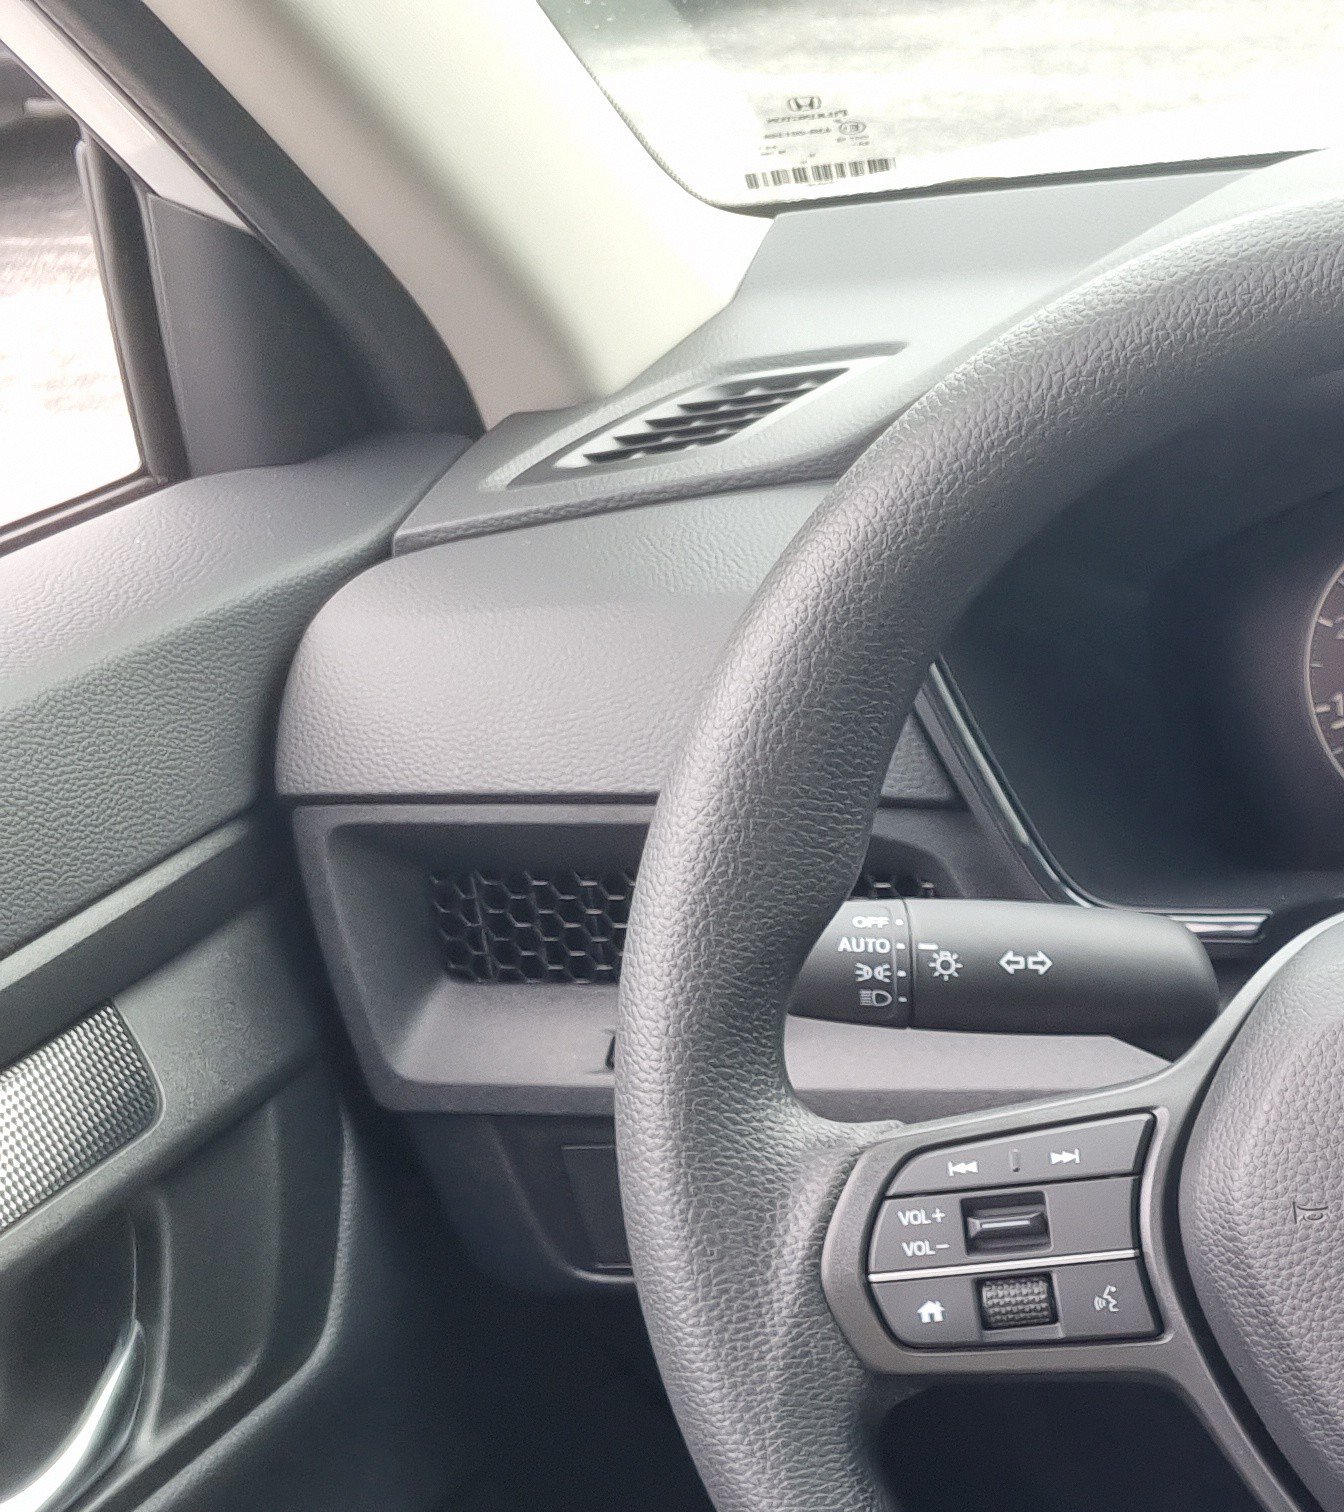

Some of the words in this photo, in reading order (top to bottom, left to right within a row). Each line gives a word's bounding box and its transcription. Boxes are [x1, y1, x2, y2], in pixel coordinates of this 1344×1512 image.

[1332, 692, 1344, 717] 1
[852, 916, 890, 929] OFF
[837, 936, 891, 954] AUTO
